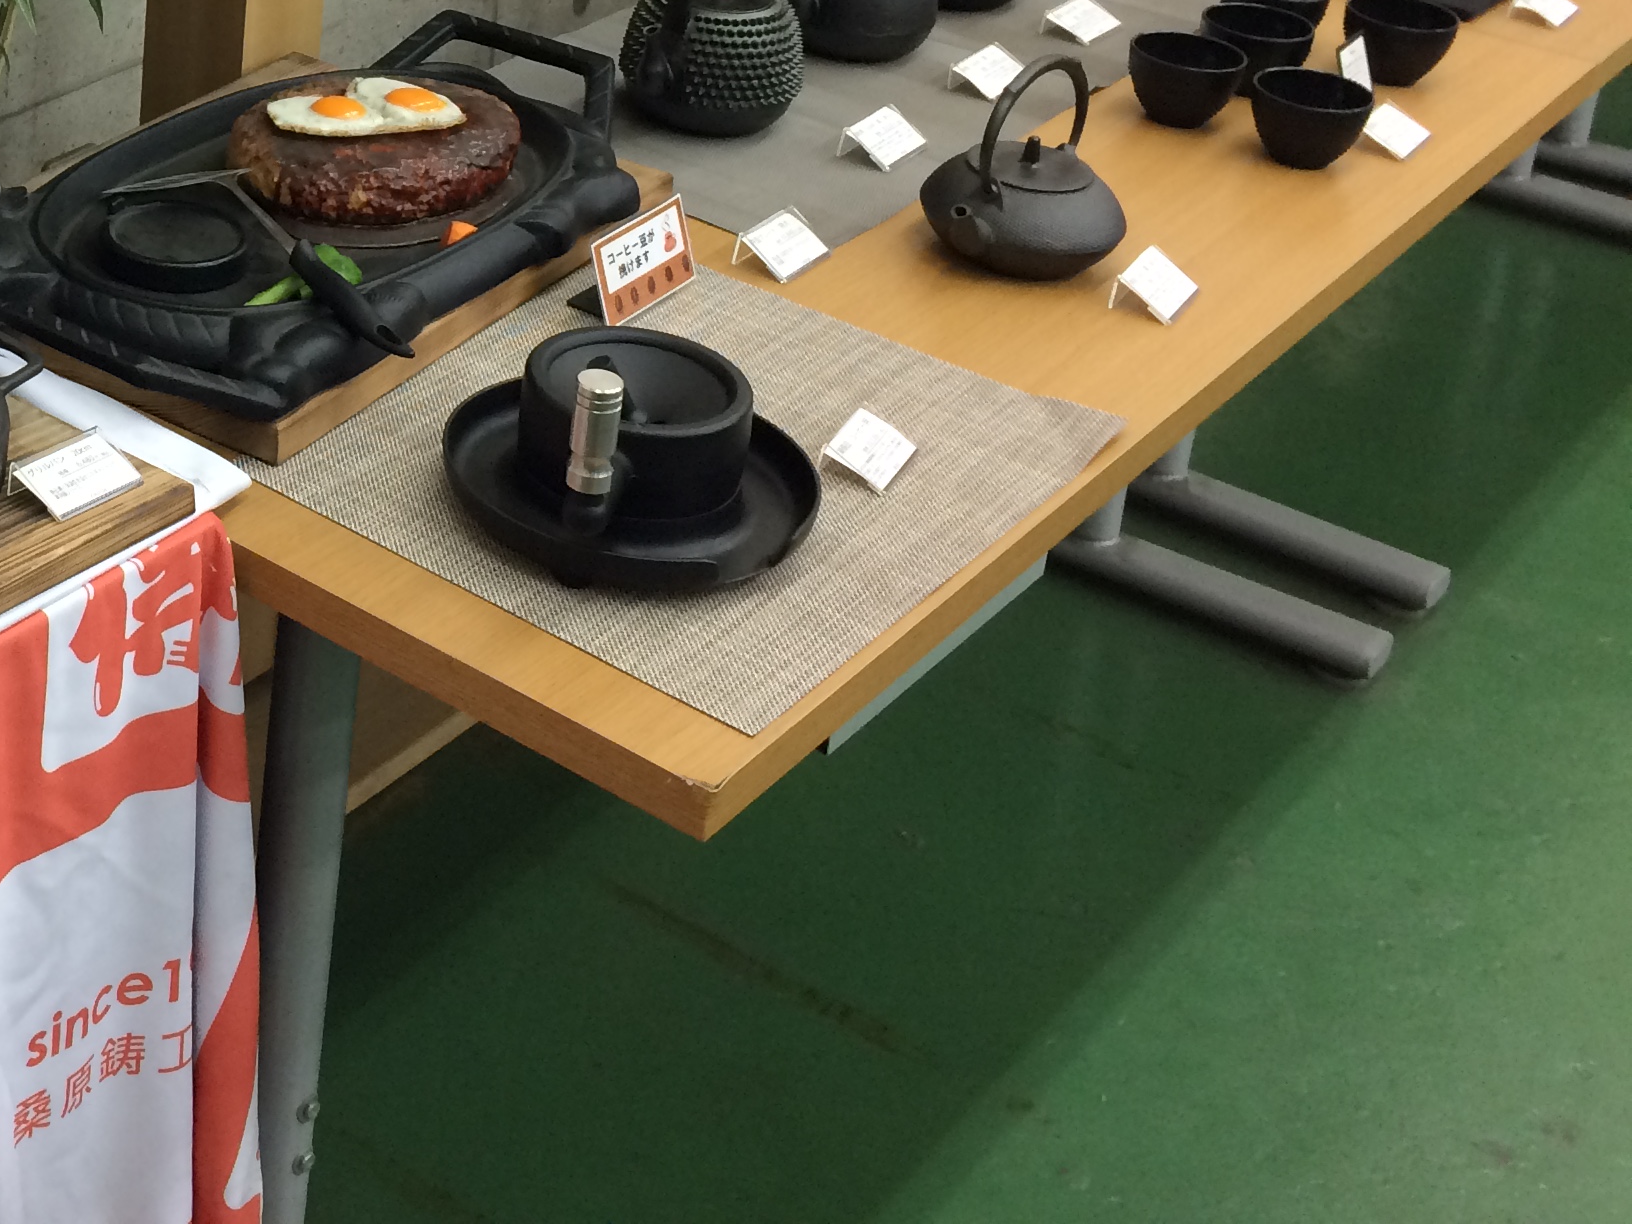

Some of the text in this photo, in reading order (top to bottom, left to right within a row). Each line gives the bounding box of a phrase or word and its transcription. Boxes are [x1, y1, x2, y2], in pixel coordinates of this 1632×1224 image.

[607, 228, 656, 265] コーヒー豆が
[26, 959, 193, 1068] since1
